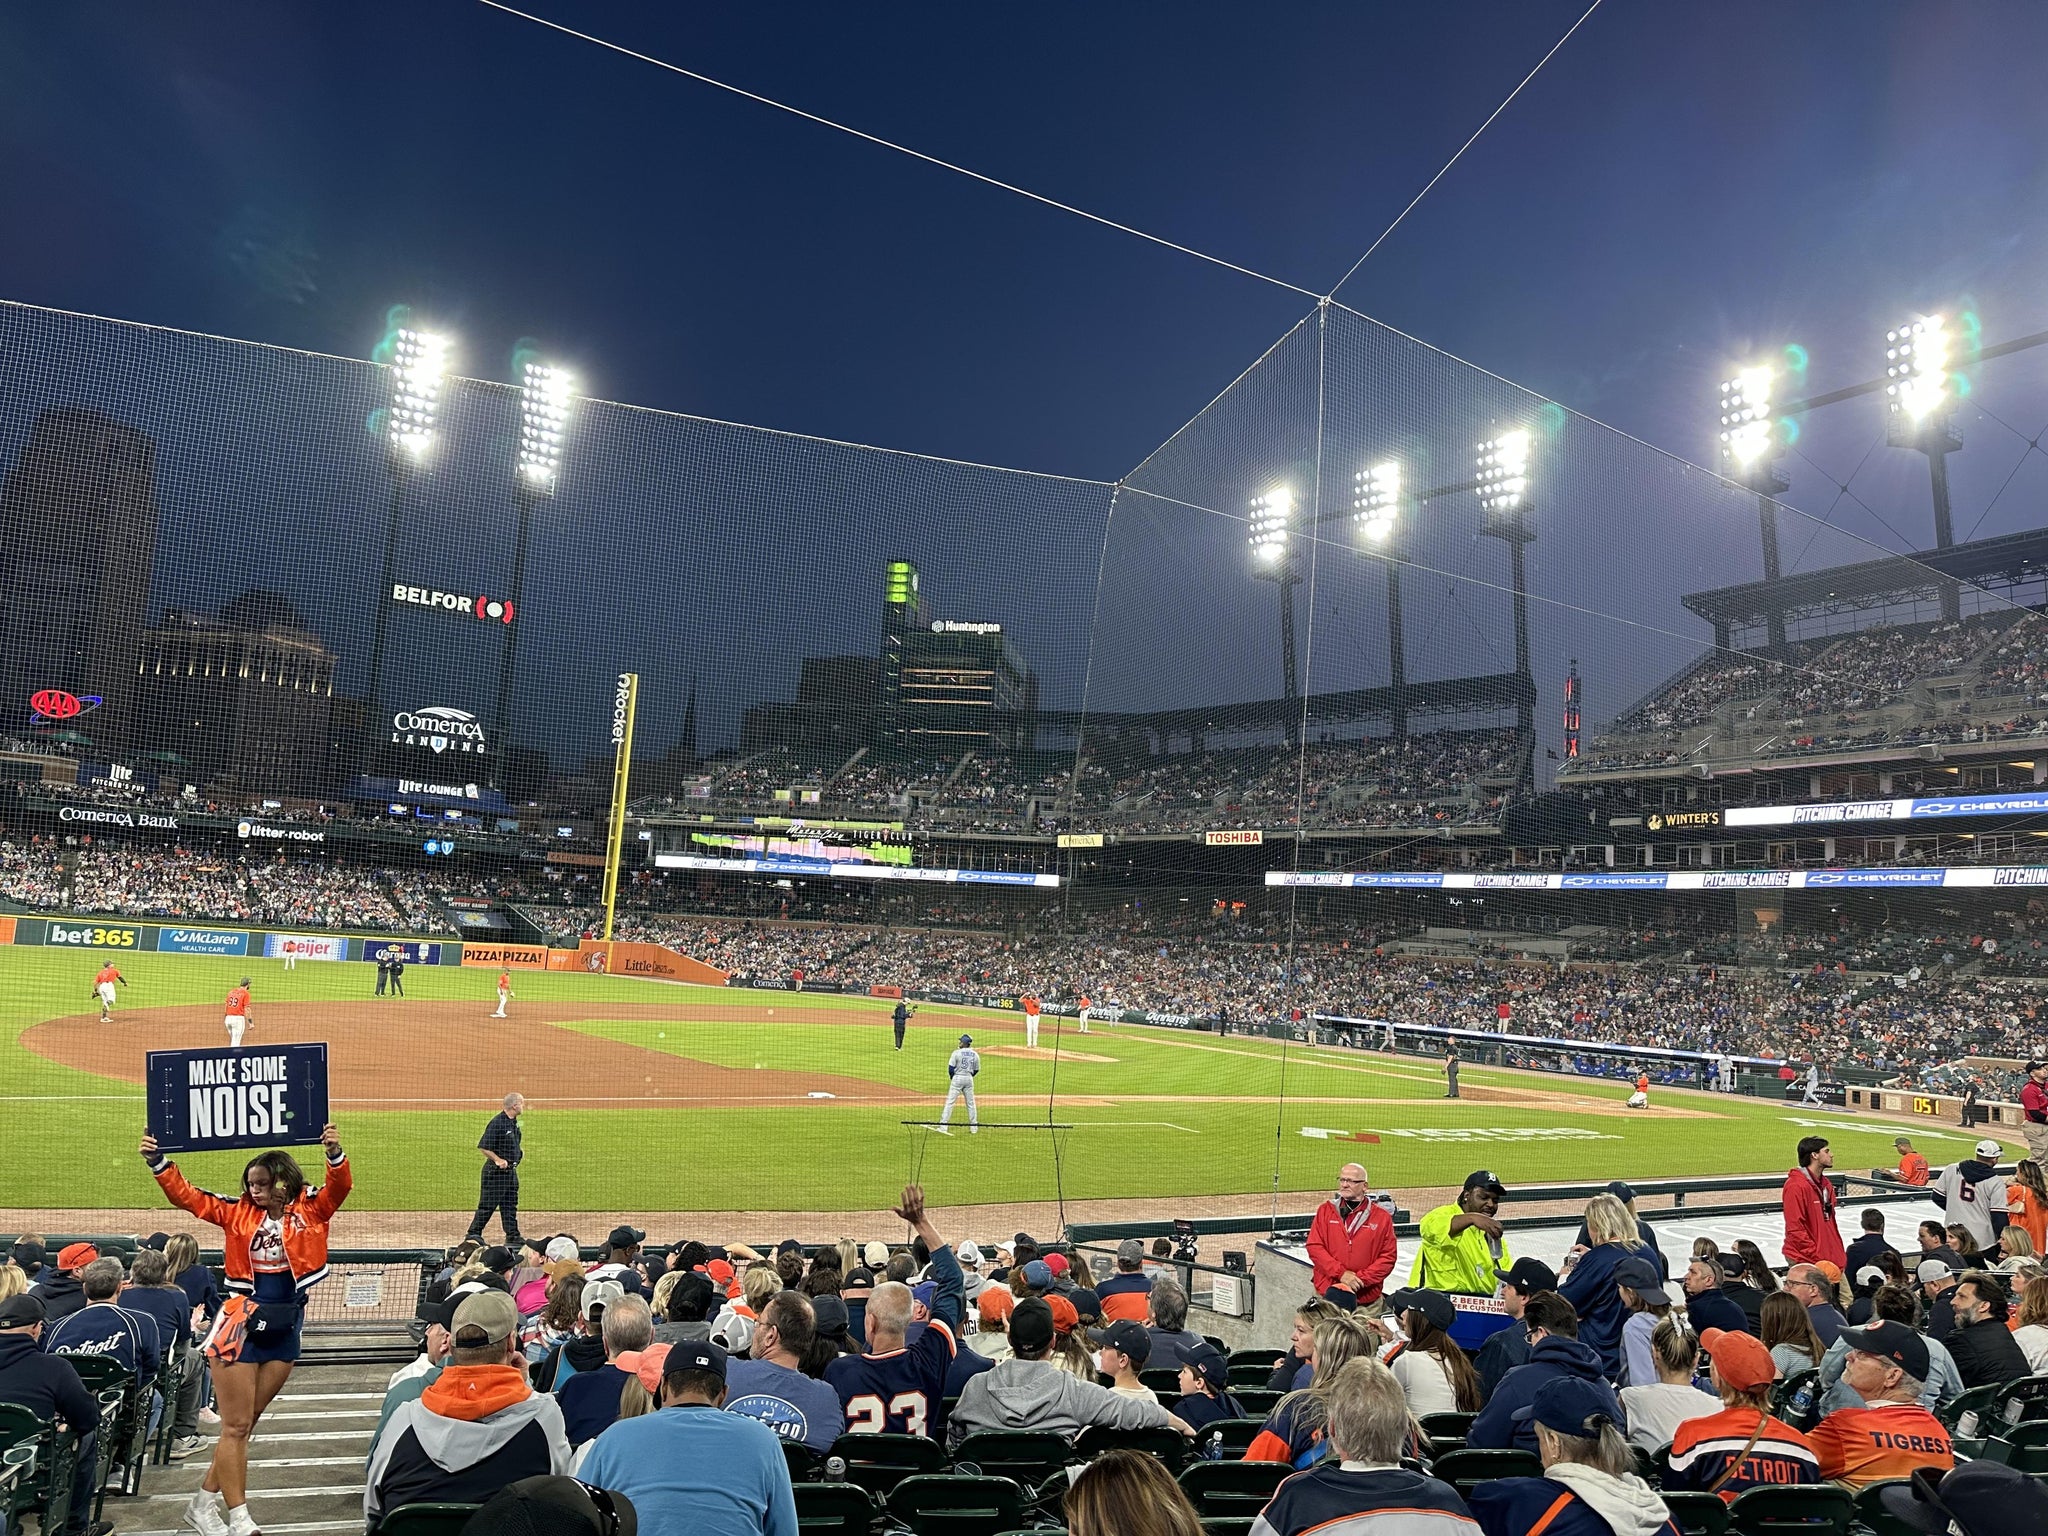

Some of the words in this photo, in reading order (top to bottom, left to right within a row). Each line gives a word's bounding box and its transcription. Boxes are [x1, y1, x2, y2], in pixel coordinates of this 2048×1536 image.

[392, 584, 472, 613] BELFOR
[945, 620, 1001, 634] Huntington
[38, 692, 74, 715] AAA
[611, 688, 630, 744] Rocket
[109, 763, 132, 781] Lite
[91, 777, 130, 790] PITCHER'S
[131, 783, 145, 792] PUB
[398, 779, 422, 794] Lite
[423, 784, 463, 797] LOUNGE
[138, 814, 179, 829] Bank
[1665, 812, 1719, 826] WINTER'S
[1793, 804, 1845, 823] PITCHING
[1846, 803, 1893, 820] CHANGE
[853, 830, 880, 839] TIGER
[890, 832, 913, 840] CLUB
[1208, 833, 1260, 843] TOSHIBA
[1474, 875, 1513, 887] PITCHING
[1512, 875, 1547, 887] CHANGE
[1703, 873, 1749, 887] PITCHING
[1749, 872, 1789, 886] CHANGE
[1848, 874, 1942, 882] CHEVROLET
[51, 926, 134, 946] bet365
[189, 933, 238, 945] McLaren
[463, 950, 501, 961] PIZZA!
[503, 951, 543, 963] PIZZA!
[625, 959, 652, 971] Little
[987, 998, 1014, 1008] bet365
[188, 1058, 236, 1086] MAKE
[240, 1055, 288, 1083] SOME
[189, 1083, 289, 1139] NOISE
[1913, 1097, 1939, 1115] 051
[1959, 1178, 1976, 1202] 6
[1460, 1297, 1485, 1306] BEER
[56, 1331, 126, 1356] Detroit
[846, 1390, 927, 1436] 23
[1869, 1432, 1944, 1454] TIGRES
[1725, 1455, 1800, 1484] DETROIT
